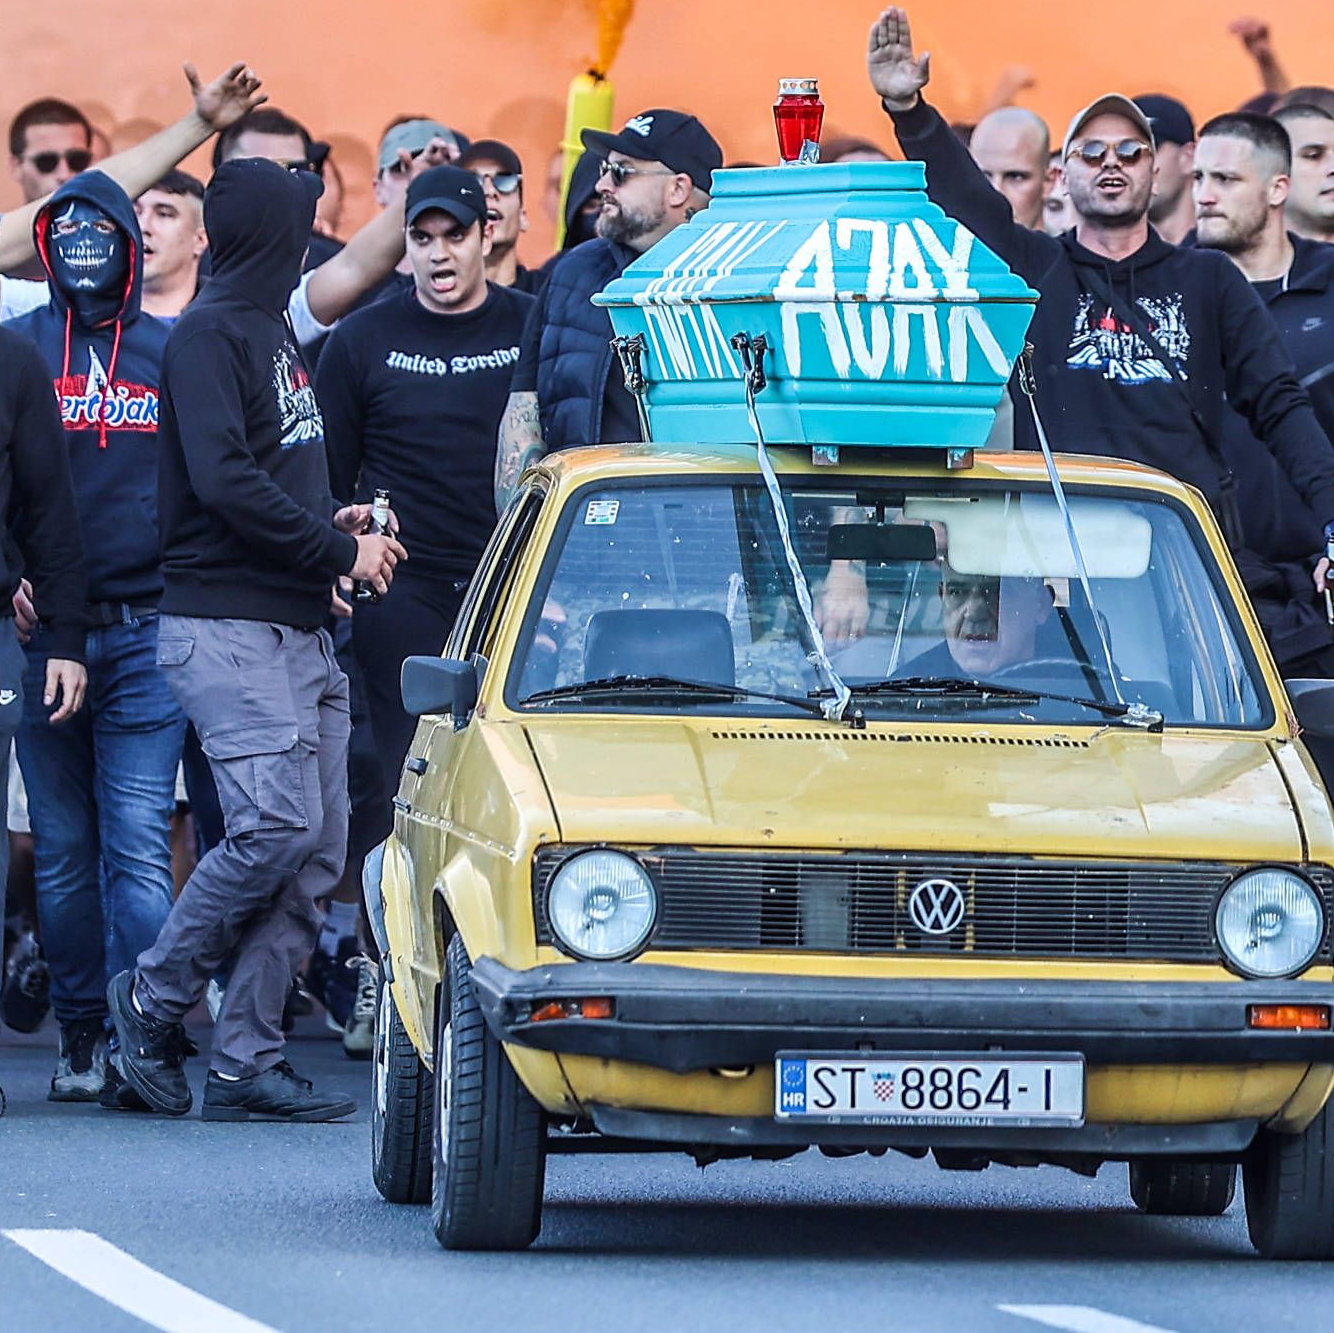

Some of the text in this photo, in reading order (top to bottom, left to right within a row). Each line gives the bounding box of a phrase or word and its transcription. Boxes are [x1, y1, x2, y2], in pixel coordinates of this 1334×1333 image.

[386, 346, 521, 376] United Torcida
[55, 386, 159, 427] ertojak
[782, 1091, 805, 1107] HR
[813, 1067, 866, 1109] ST
[863, 1115, 915, 1126] CROATIA
